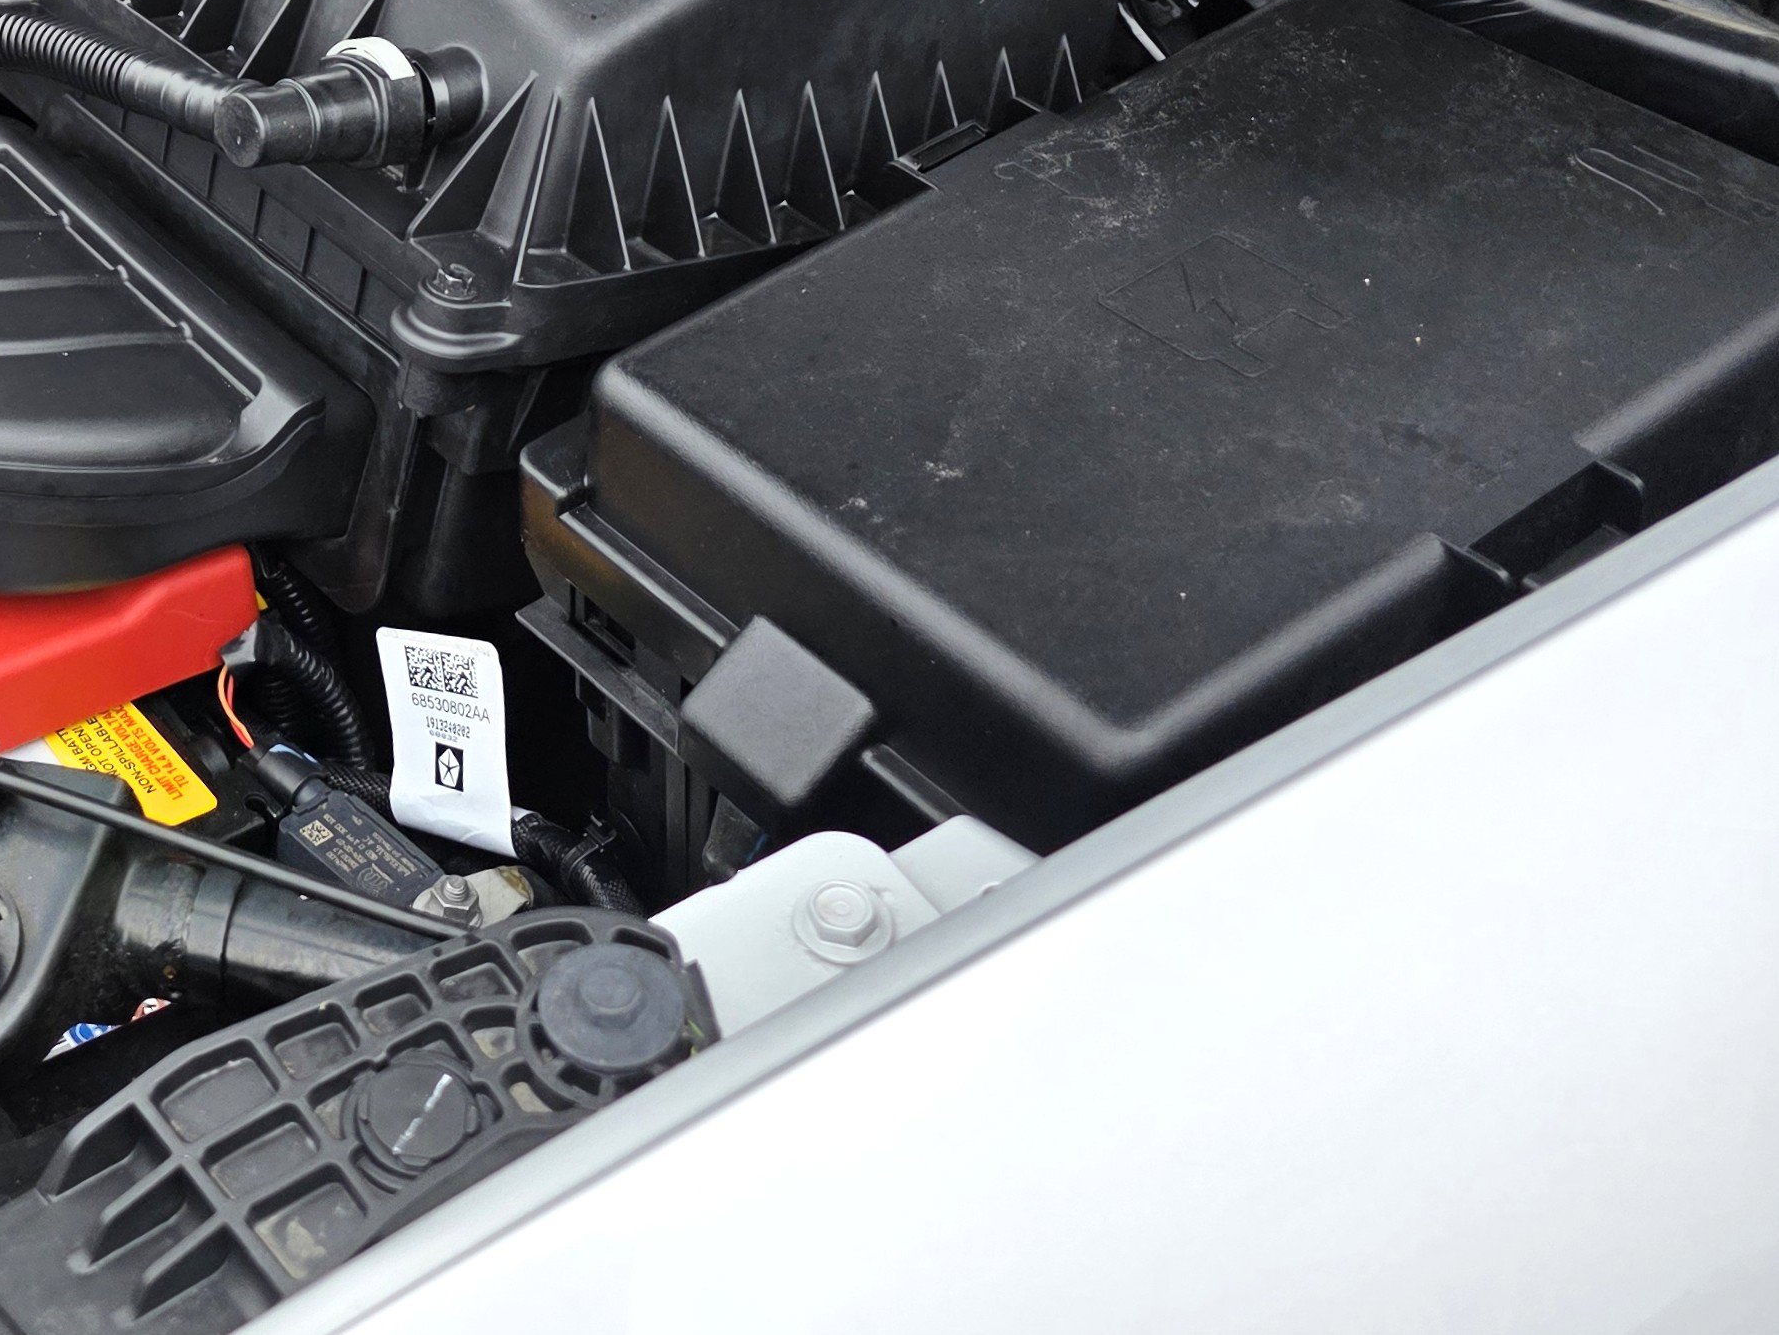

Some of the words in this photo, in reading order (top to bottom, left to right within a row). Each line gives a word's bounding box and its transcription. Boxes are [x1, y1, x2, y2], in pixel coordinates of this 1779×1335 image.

[411, 692, 491, 724] 68530802AA
[85, 715, 156, 794] NON-SPILLABLE
[130, 726, 161, 755] VOLTS
[78, 755, 99, 774] GM
[124, 738, 161, 775] CHARGE
[155, 754, 178, 774] 14.4
[154, 773, 183, 800] LIMIT
[172, 773, 189, 787] TO
